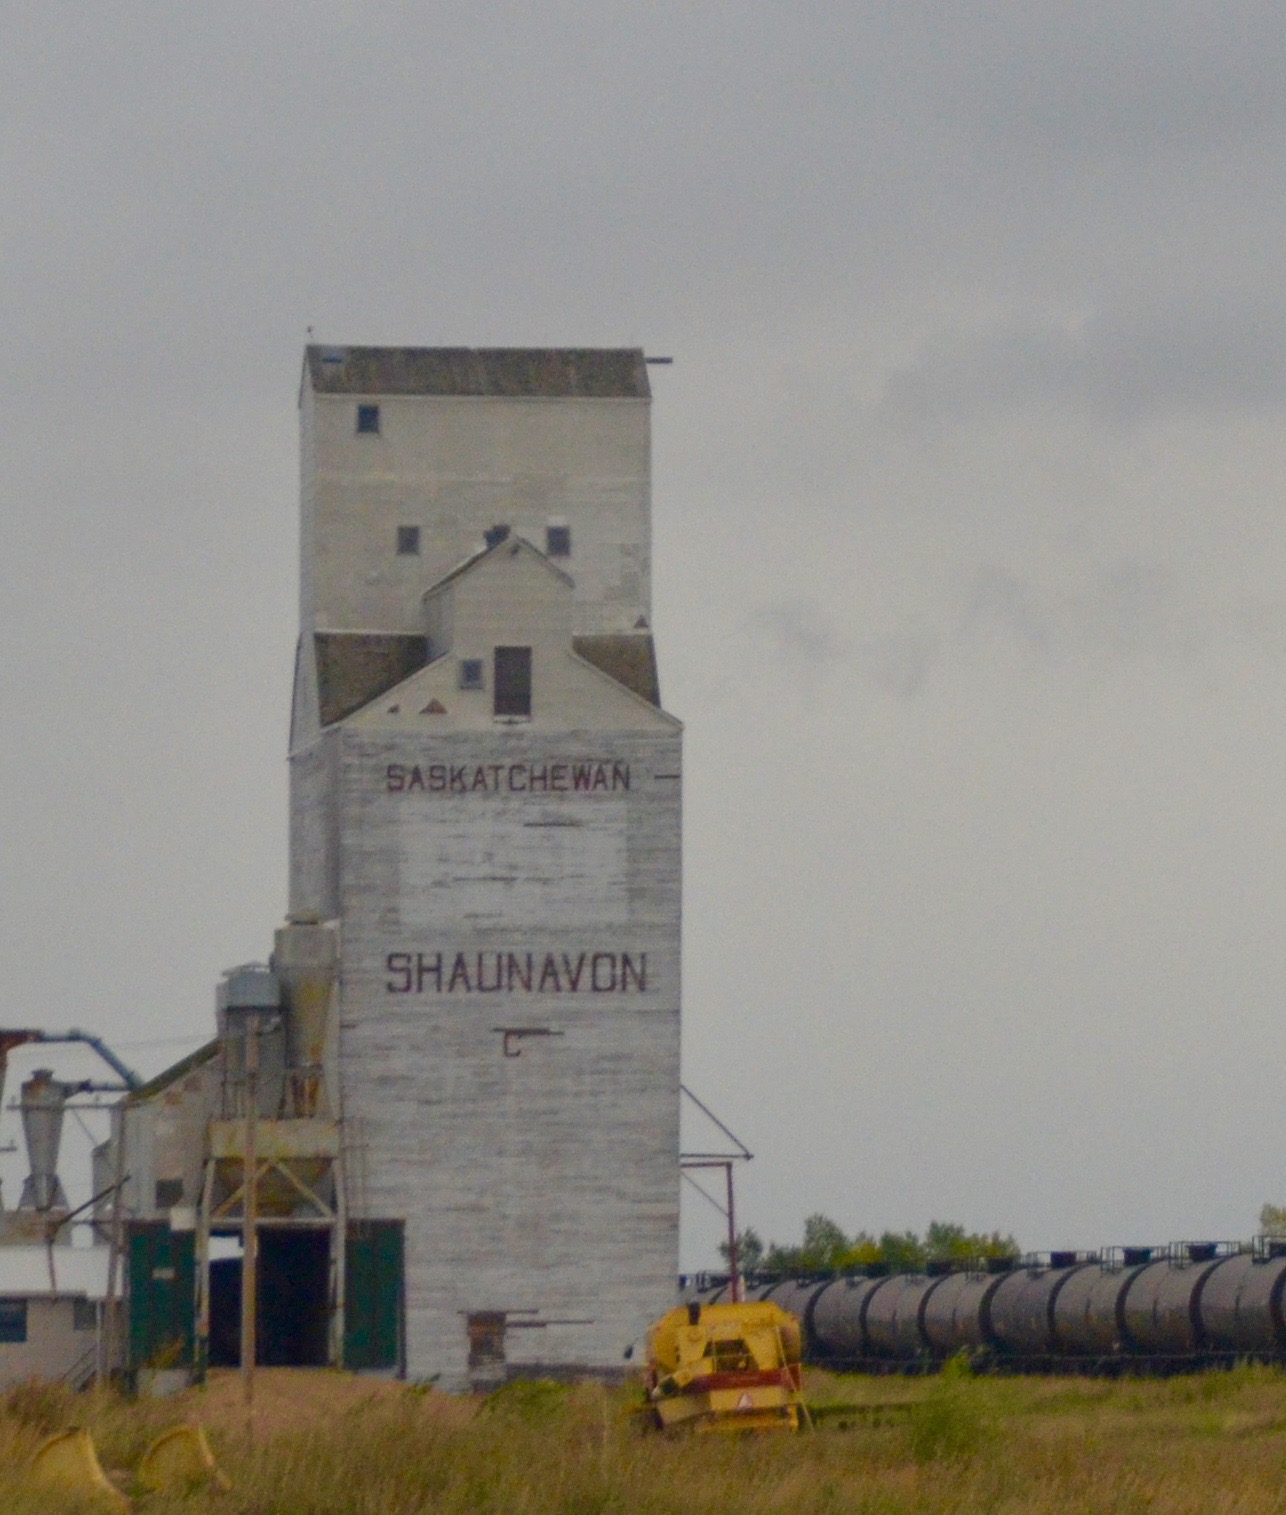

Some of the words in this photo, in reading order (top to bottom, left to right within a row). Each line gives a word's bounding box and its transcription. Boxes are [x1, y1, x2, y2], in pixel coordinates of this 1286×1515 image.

[386, 763, 632, 793] SASKATCHEWAN
[386, 951, 648, 994] SHAUNAVON
[502, 1029, 524, 1058] C
